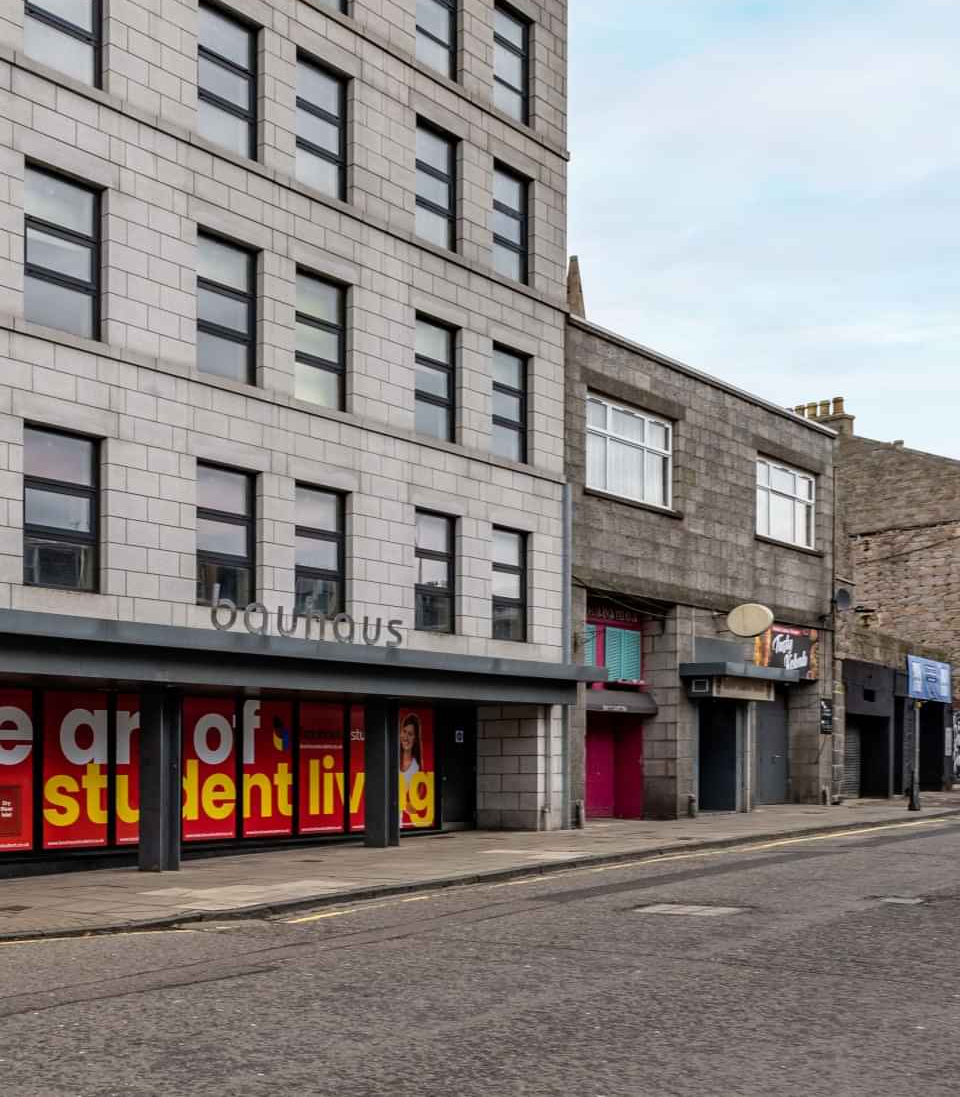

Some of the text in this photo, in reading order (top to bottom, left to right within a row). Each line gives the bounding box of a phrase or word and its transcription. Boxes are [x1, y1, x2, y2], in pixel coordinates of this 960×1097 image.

[210, 582, 404, 648] bauhaus
[59, 707, 140, 766] ar
[193, 699, 261, 765] of
